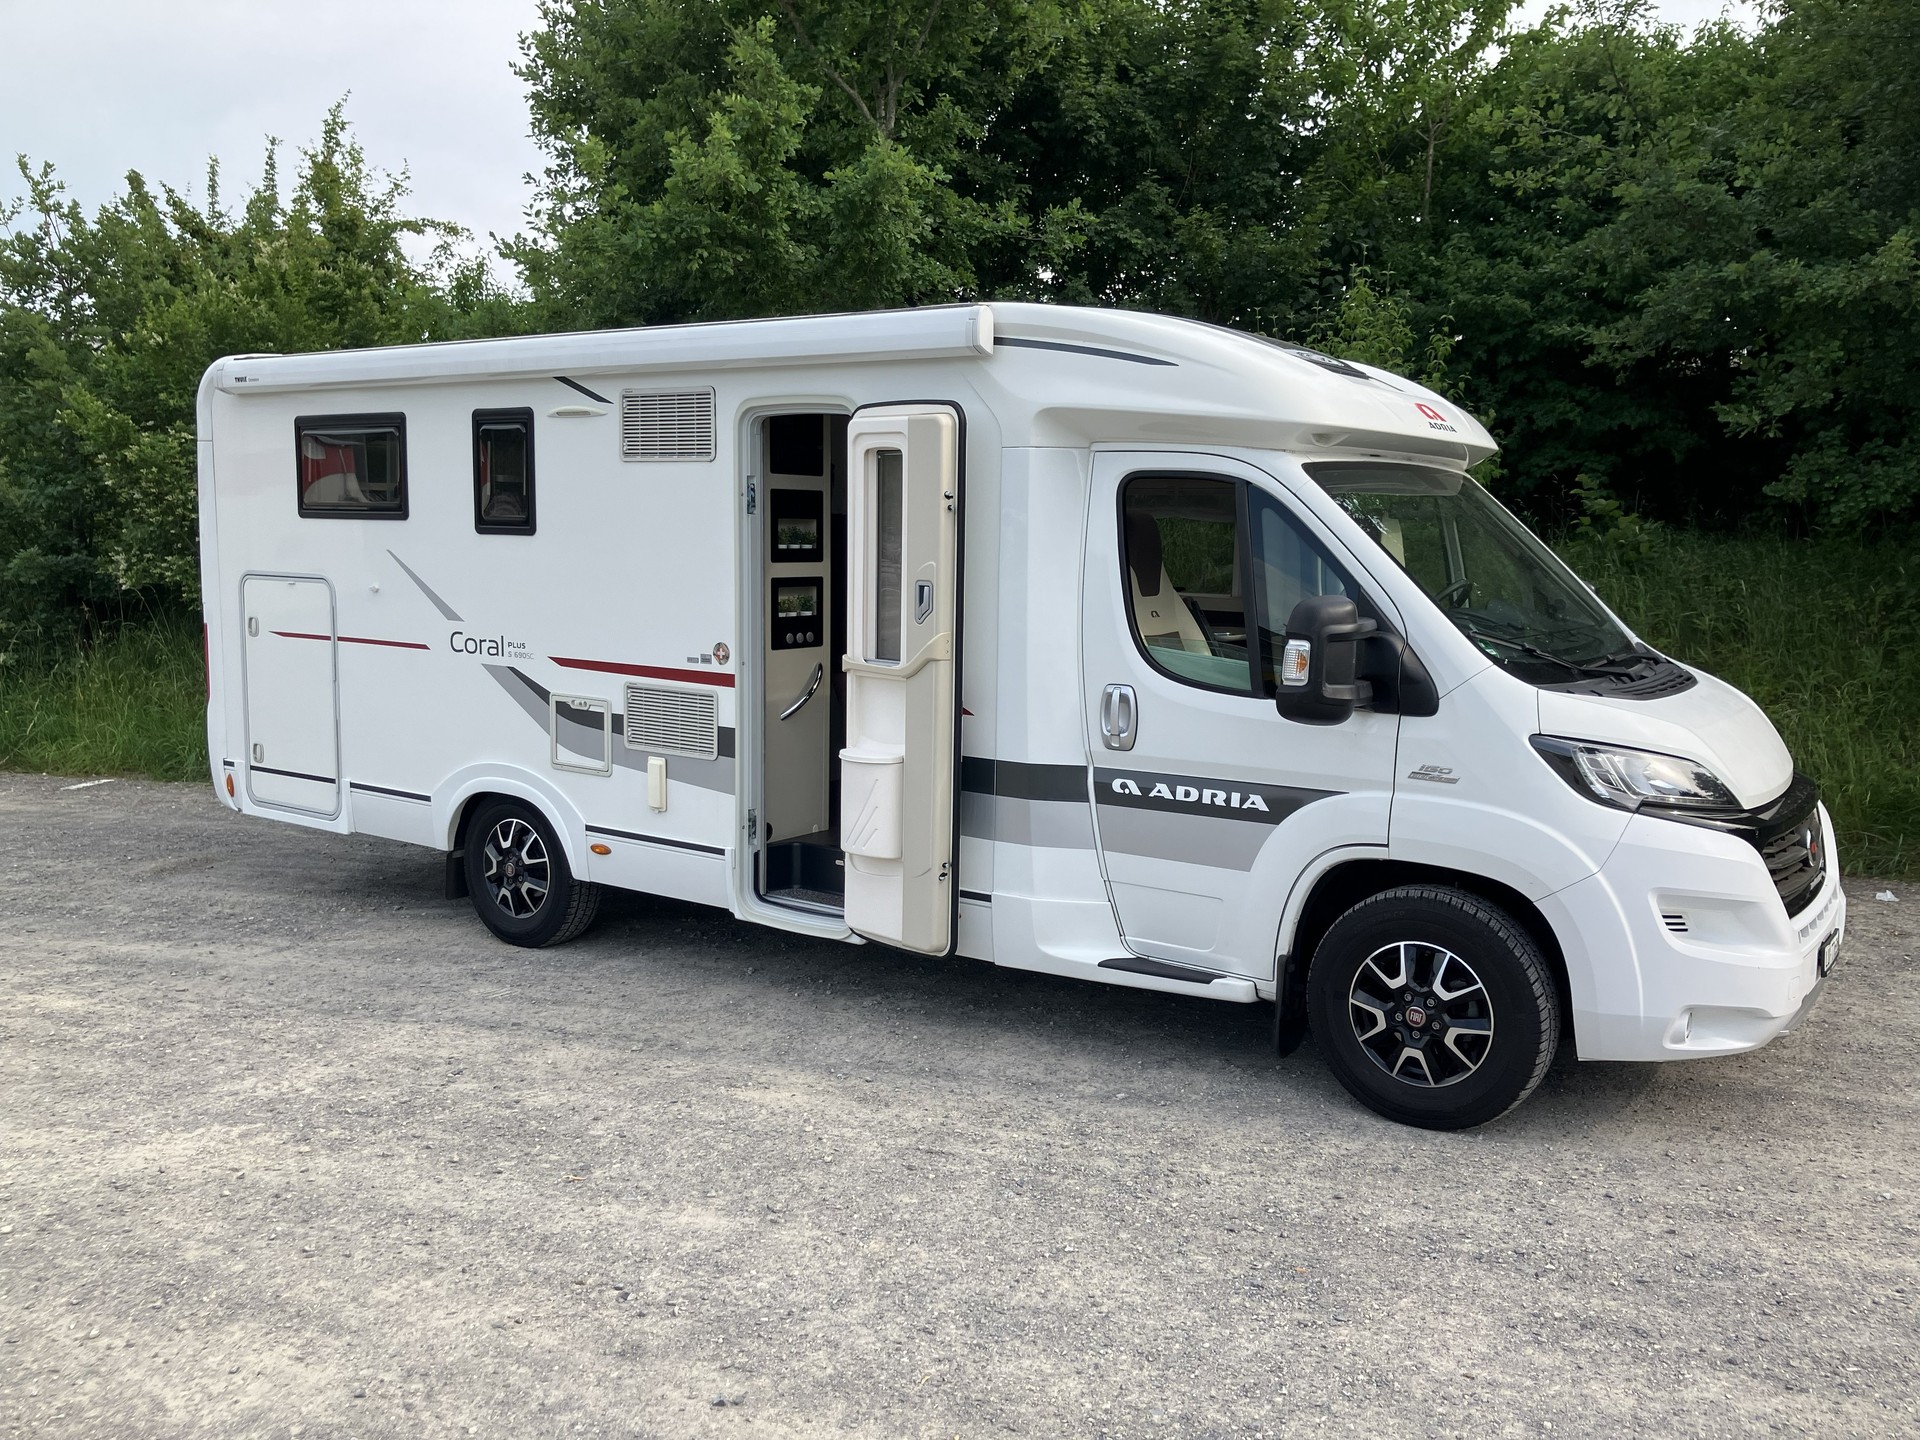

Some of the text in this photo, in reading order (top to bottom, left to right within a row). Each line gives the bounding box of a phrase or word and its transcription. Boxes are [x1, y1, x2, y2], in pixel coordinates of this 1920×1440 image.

[1428, 421, 1458, 433] ADRIA
[450, 631, 526, 657] Coral PLUS
[1148, 782, 1270, 812] ADRIA
[1410, 1011, 1423, 1023] FIAT
